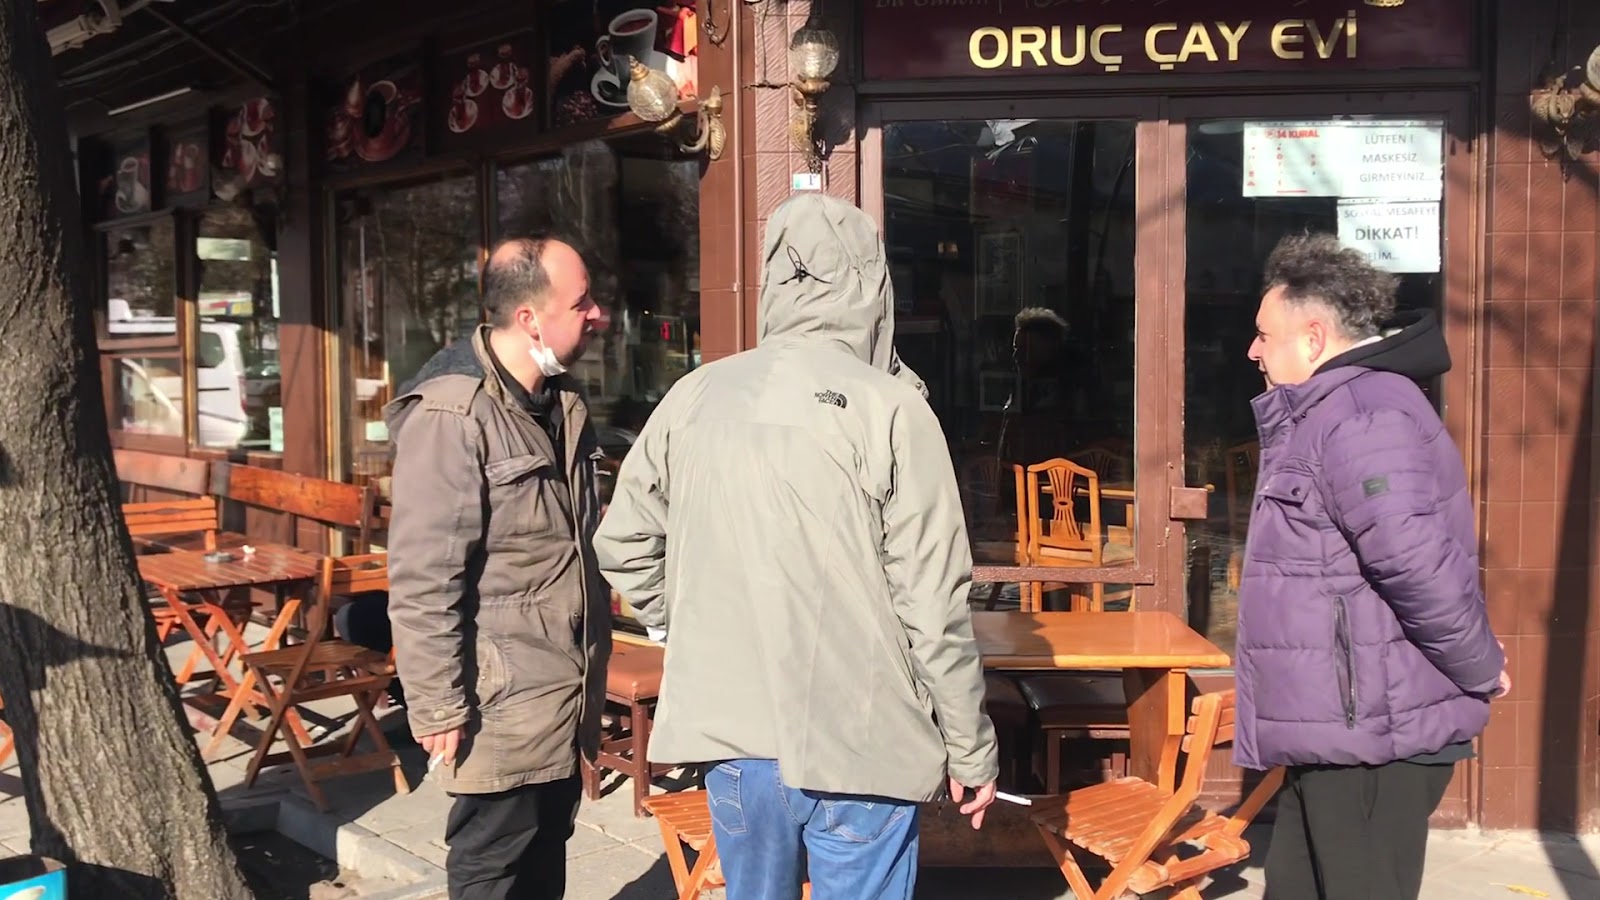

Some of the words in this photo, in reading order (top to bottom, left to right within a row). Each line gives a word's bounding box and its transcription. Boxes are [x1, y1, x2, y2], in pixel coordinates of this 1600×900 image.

[968, 24, 1123, 73] ORUÇ
[1143, 20, 1253, 70] ÇAY
[1270, 9, 1359, 60] EVİ
[1289, 129, 1320, 138] KURAL
[1362, 152, 1418, 163] MASKESİZ
